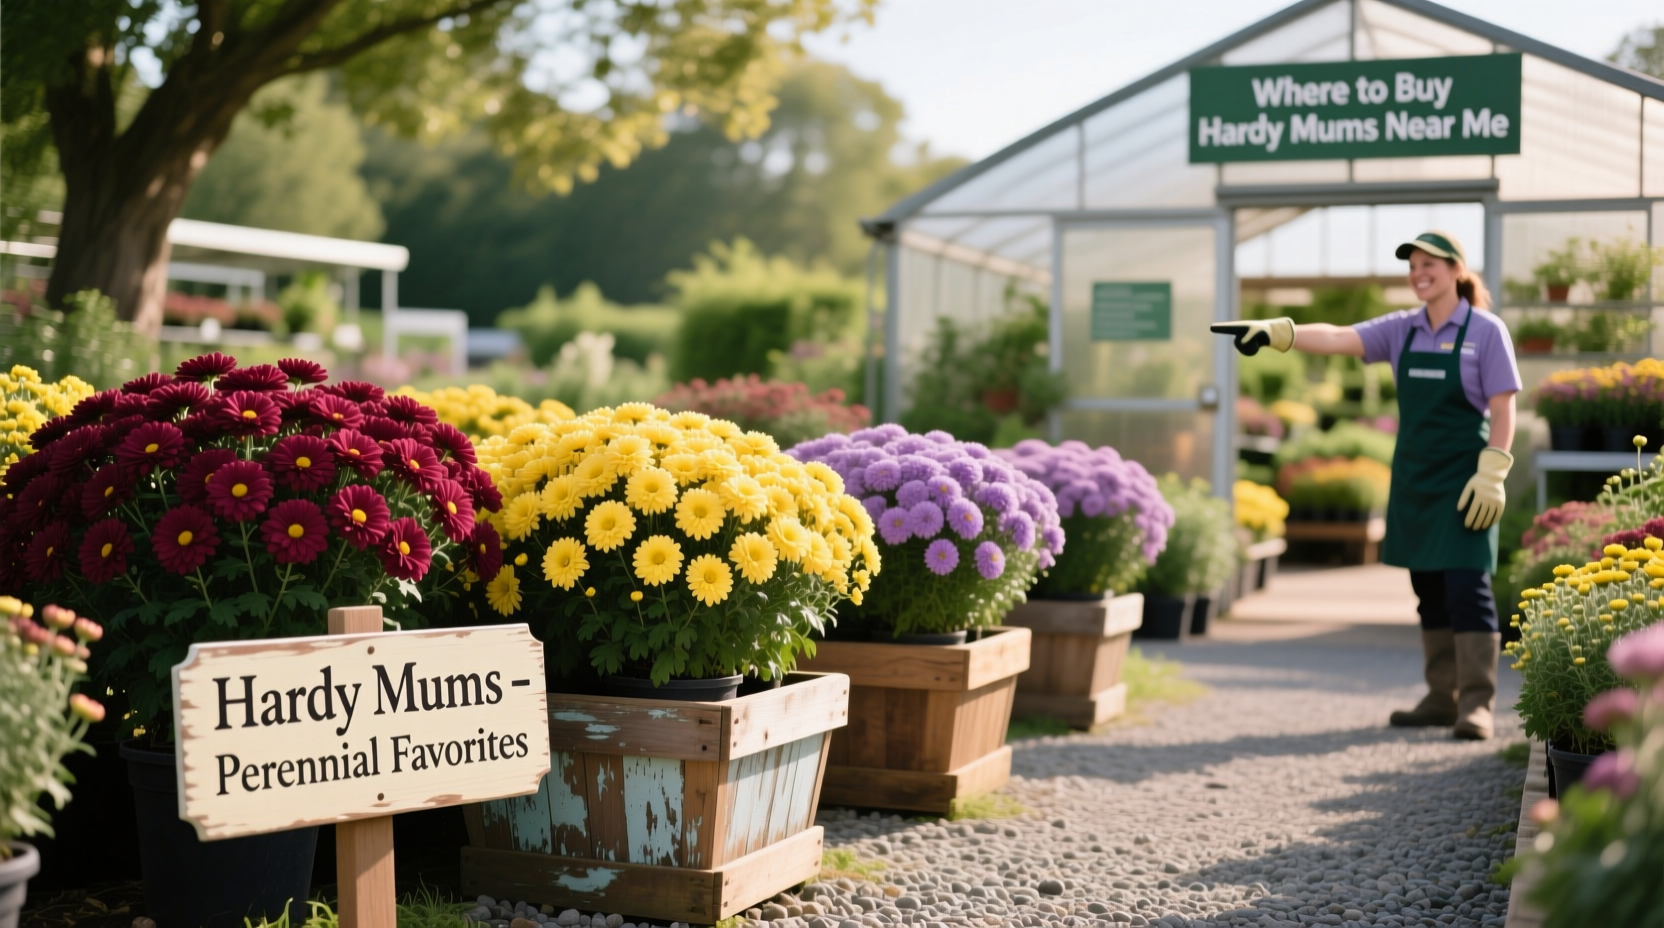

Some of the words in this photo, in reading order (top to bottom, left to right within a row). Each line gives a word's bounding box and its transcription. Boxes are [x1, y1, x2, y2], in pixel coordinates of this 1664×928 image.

[1251, 75, 1350, 108] Where
[1355, 76, 1389, 105] to
[1394, 72, 1453, 110] Buy
[1198, 113, 1285, 153] Hardy
[1289, 113, 1379, 144] Mums
[1385, 110, 1455, 142] Near
[1462, 108, 1510, 140] Me
[212, 665, 362, 736] Hardy
[372, 661, 503, 715] Mums
[215, 736, 381, 796] Perennial
[390, 727, 529, 773] Favorites
